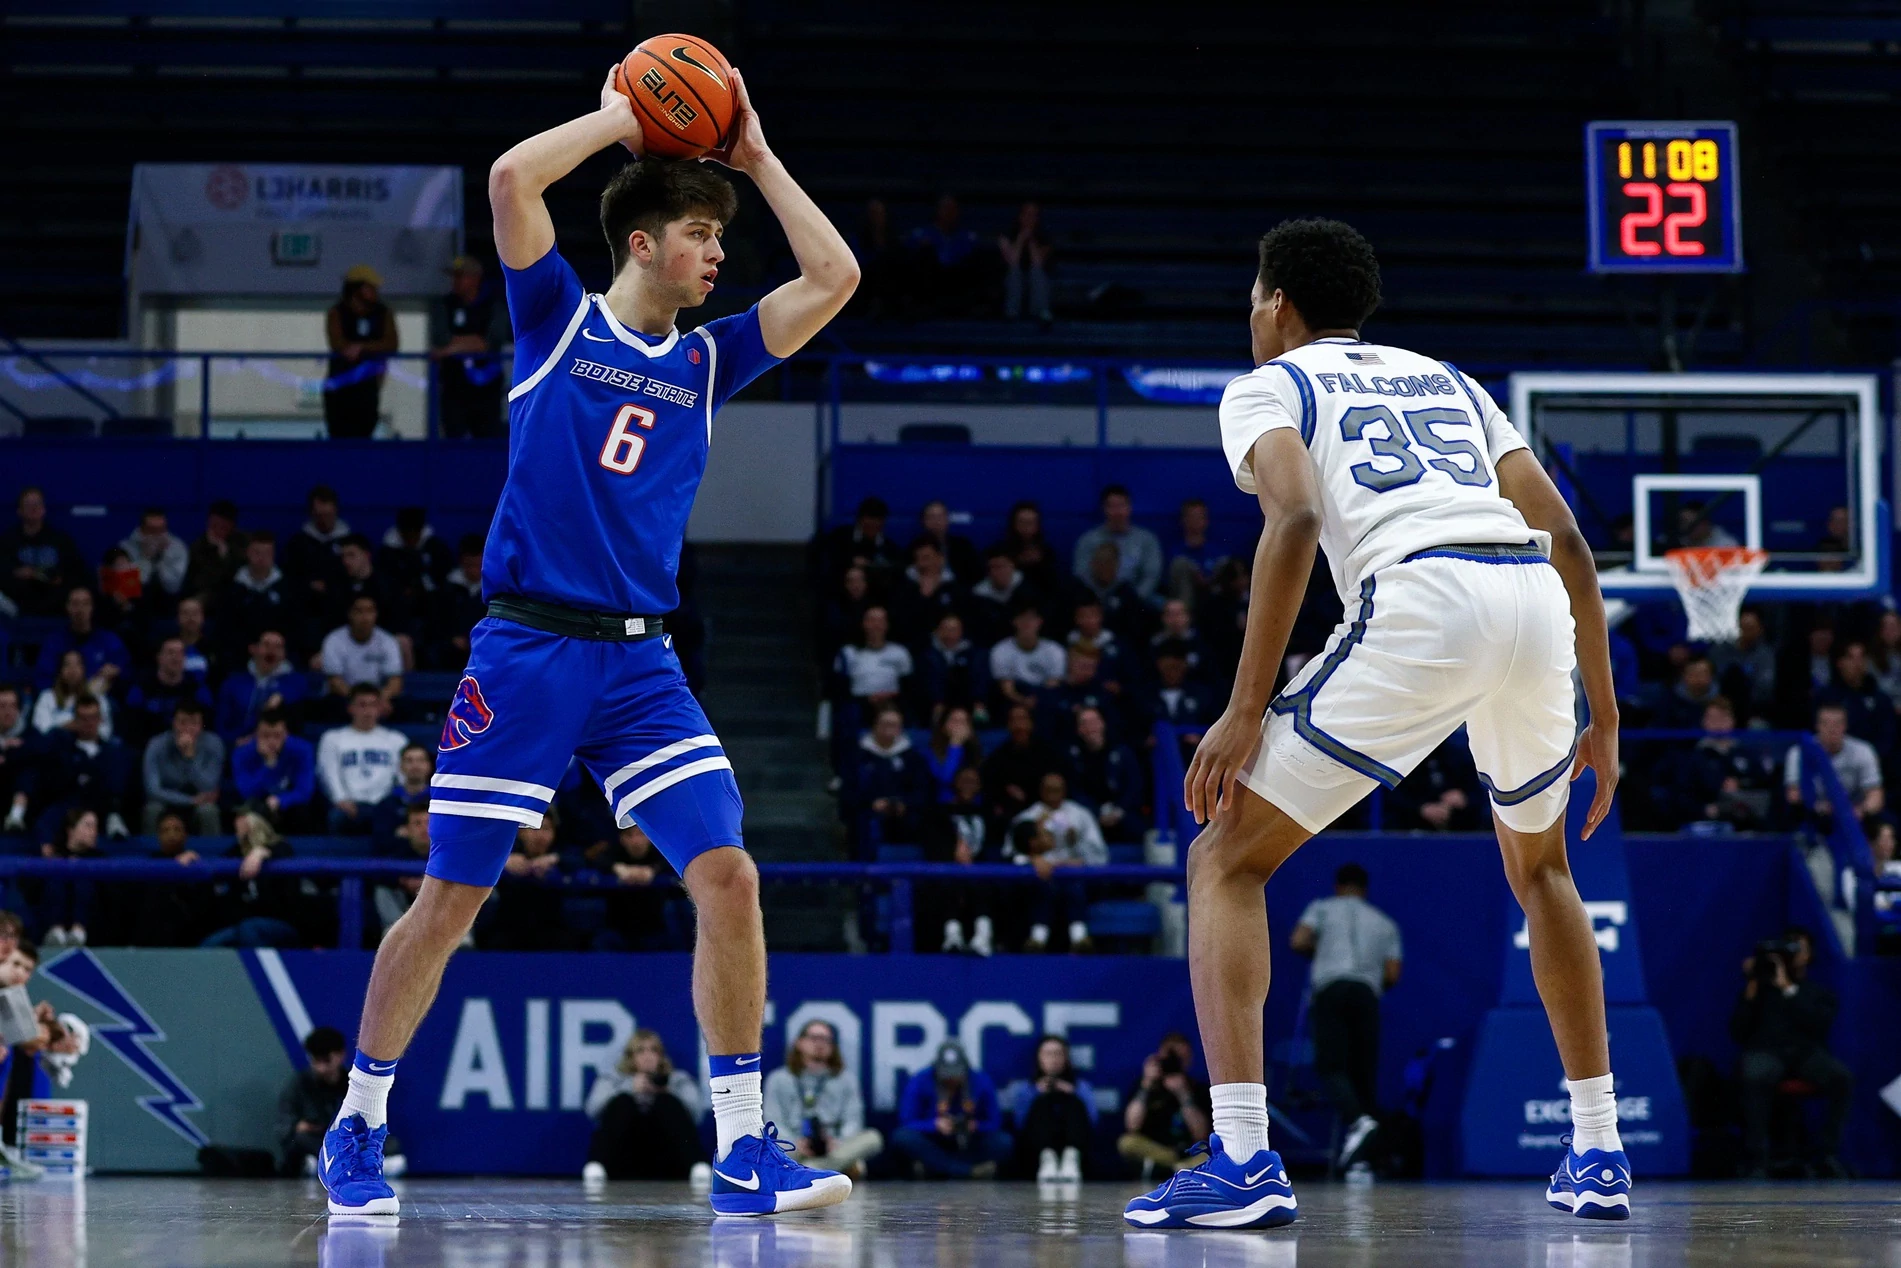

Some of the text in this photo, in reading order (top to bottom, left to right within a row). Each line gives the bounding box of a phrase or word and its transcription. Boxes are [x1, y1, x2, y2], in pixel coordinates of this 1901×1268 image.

[1620, 182, 1707, 256] 22
[570, 358, 698, 408] BOISE STATE
[1315, 372, 1457, 398] FALCONS
[598, 402, 656, 476] 6
[1339, 404, 1493, 494] 35
[439, 998, 638, 1111] AIR
[1524, 1096, 1651, 1124] EXCGE
